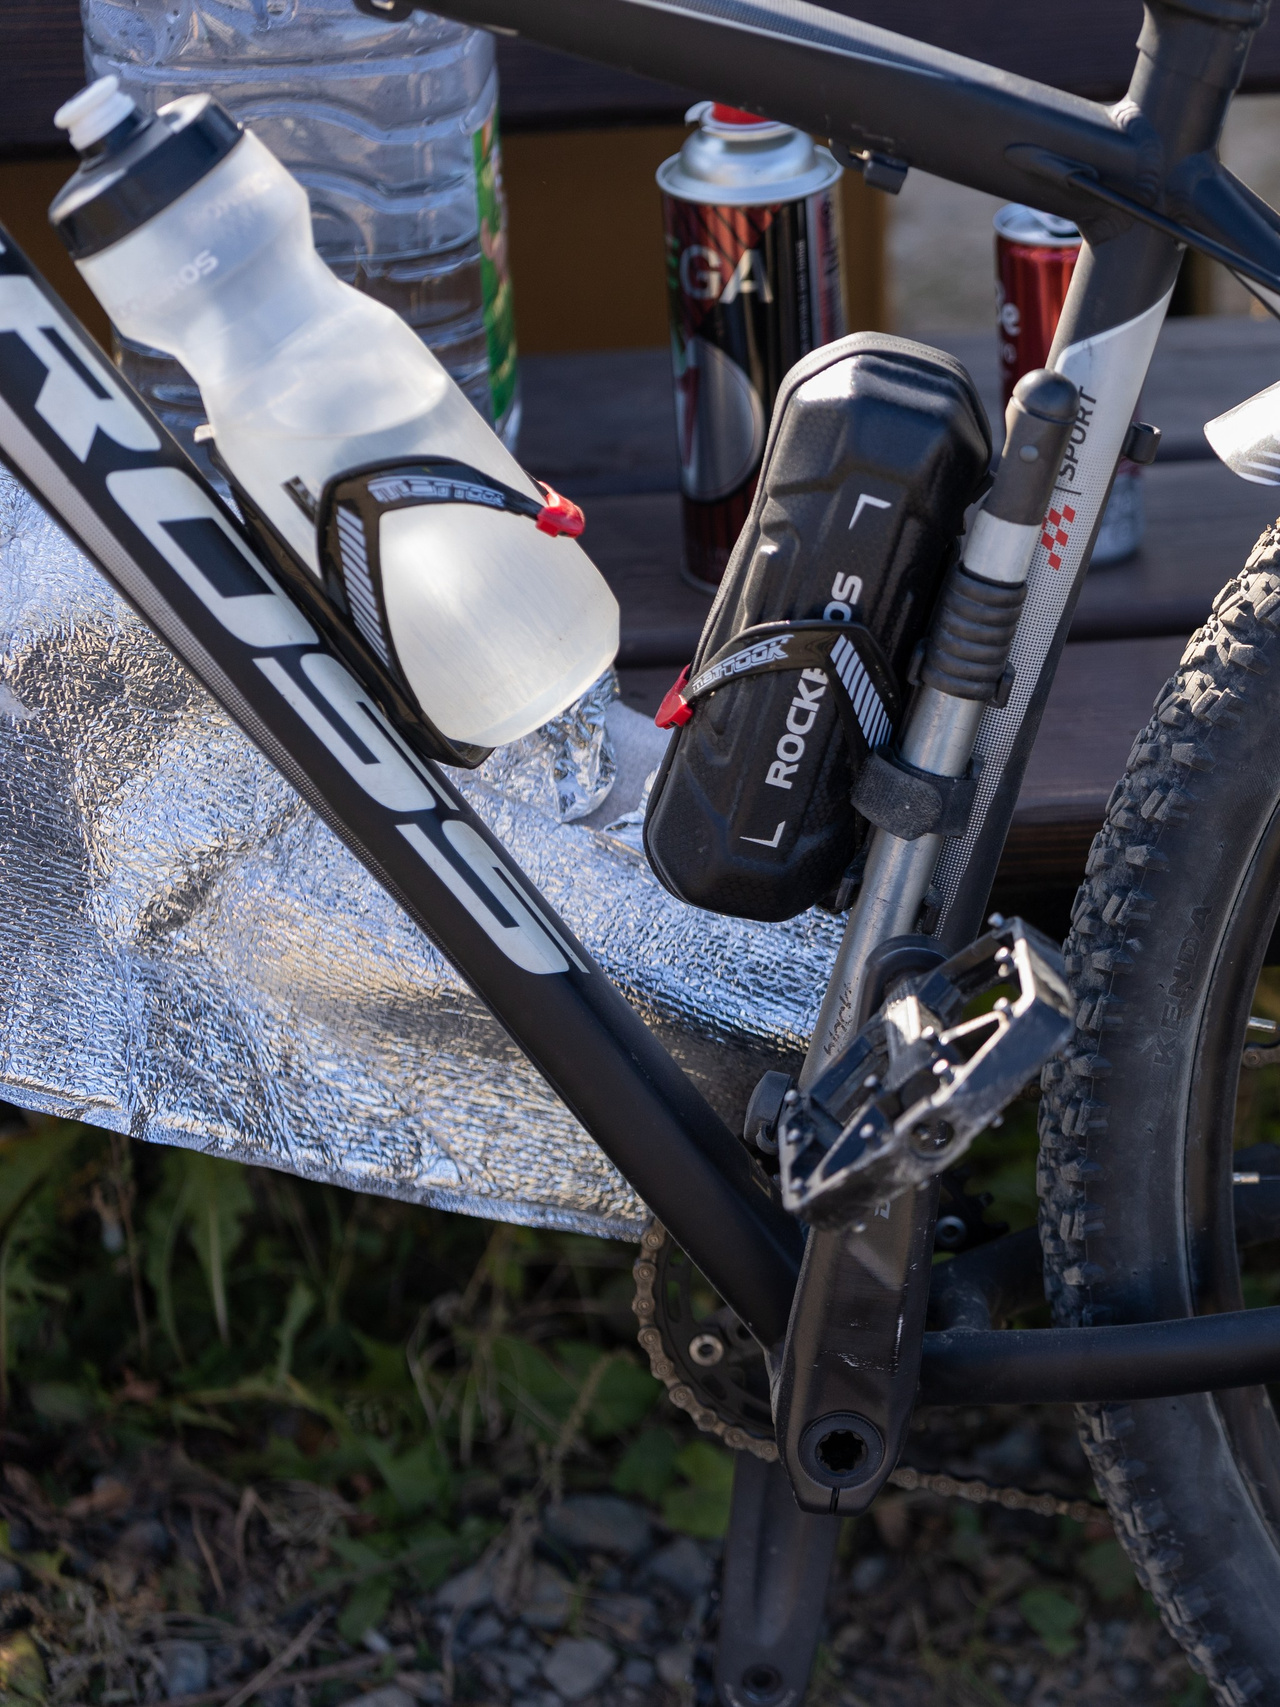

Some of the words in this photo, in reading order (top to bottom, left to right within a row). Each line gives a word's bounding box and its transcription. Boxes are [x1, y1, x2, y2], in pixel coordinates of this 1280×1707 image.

[1058, 385, 1097, 483] SPORT
[0, 240, 591, 976] ROSS
[764, 571, 864, 790] ROCKOS
[1152, 904, 1213, 1067] KENDA
